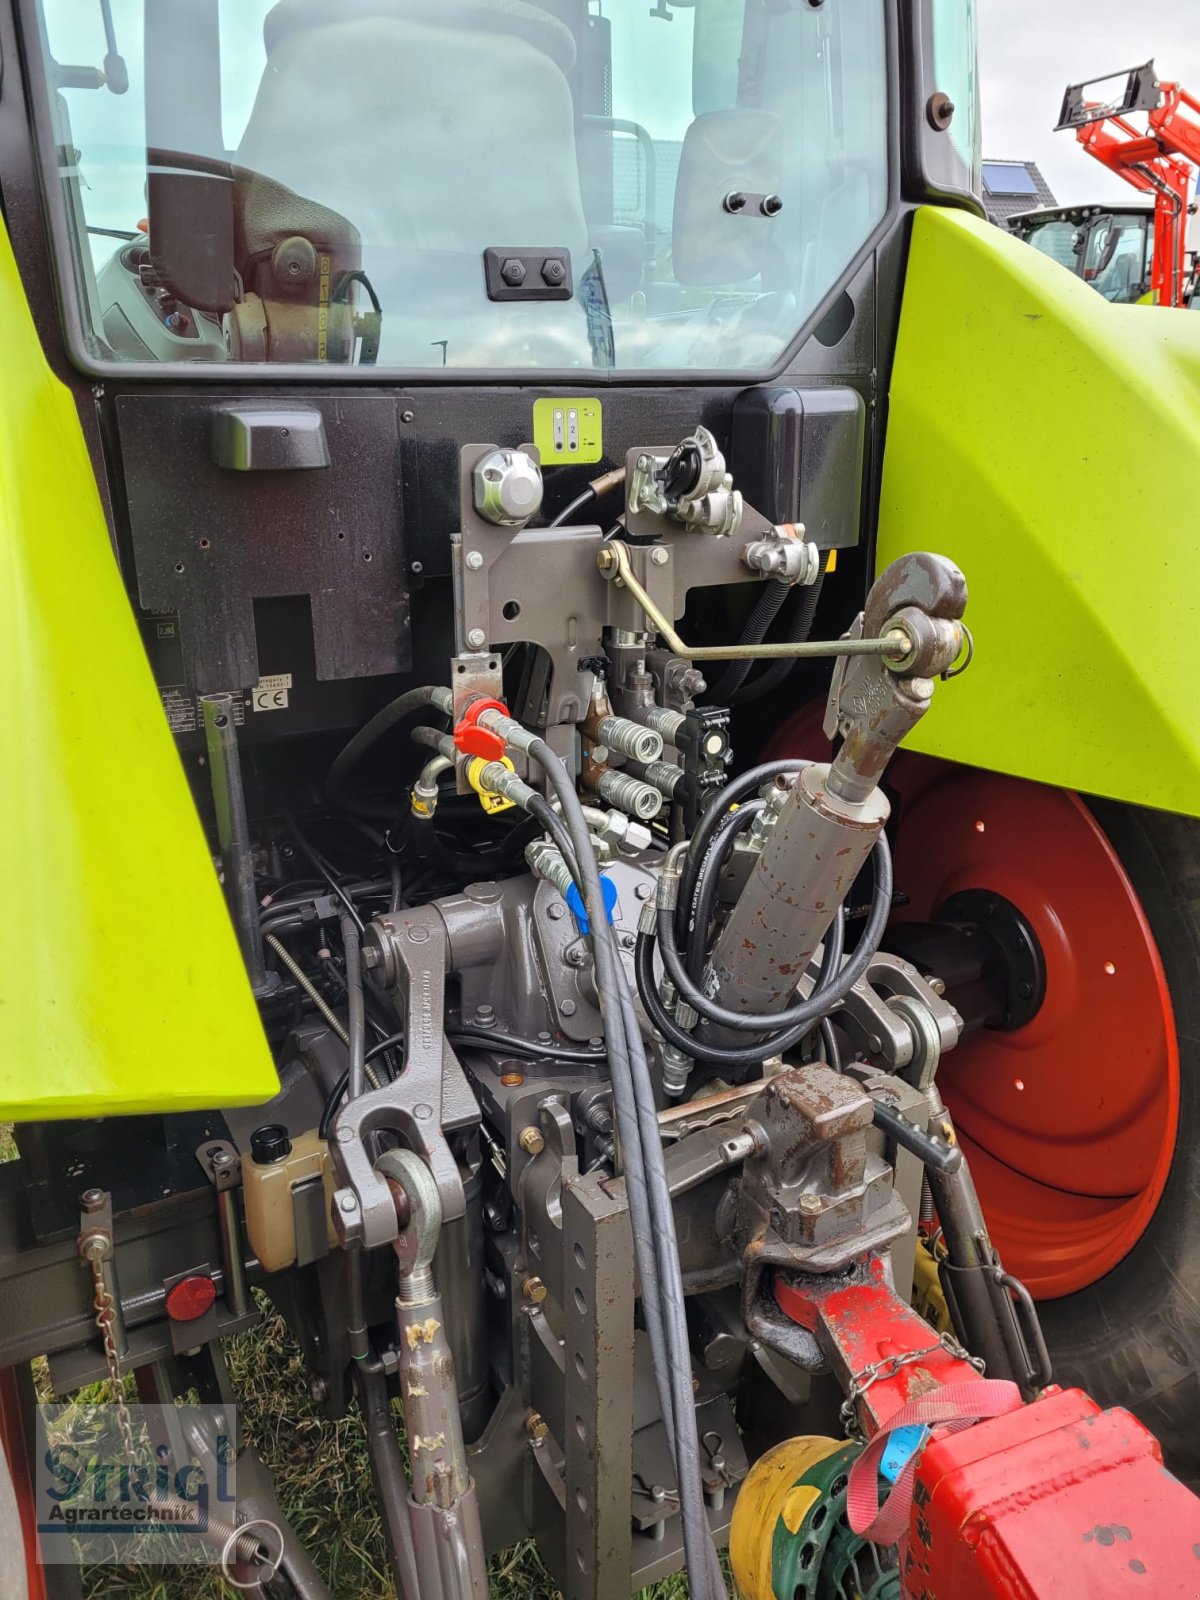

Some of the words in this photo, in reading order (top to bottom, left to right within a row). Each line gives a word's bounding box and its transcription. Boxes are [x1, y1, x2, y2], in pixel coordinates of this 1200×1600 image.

[570, 425, 576, 433] 2
[257, 690, 284, 709] CE
[691, 881, 702, 909] GATES
